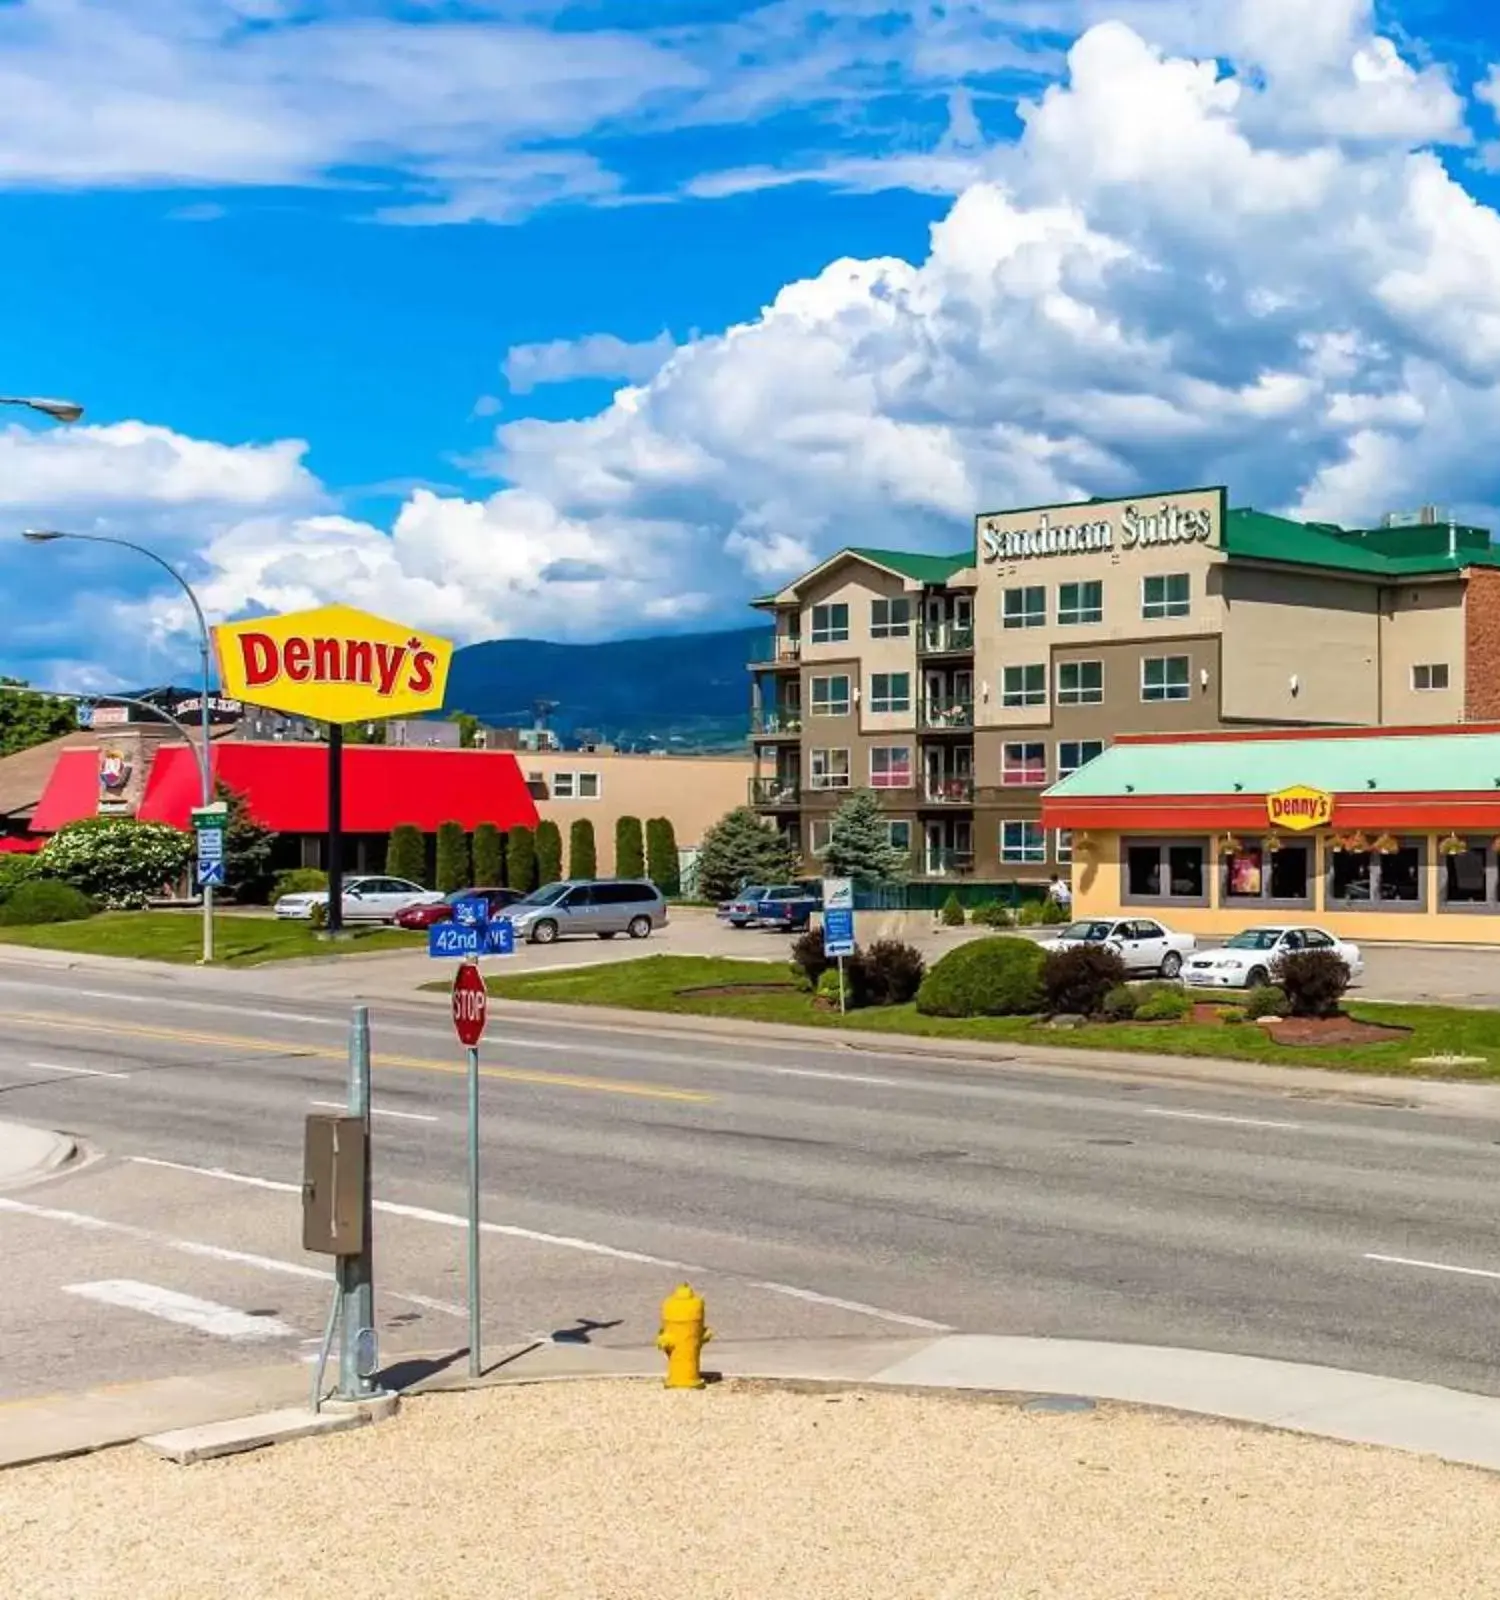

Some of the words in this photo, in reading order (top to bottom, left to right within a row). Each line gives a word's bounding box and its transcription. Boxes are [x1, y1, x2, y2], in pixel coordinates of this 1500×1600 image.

[983, 513, 1114, 562] Sandman
[1120, 502, 1212, 549] Suites
[237, 632, 436, 696] Denny's
[1271, 796, 1328, 819] Denny's
[436, 929, 477, 950] 42nd
[484, 928, 508, 947] AVE
[453, 989, 485, 1022] STOP
